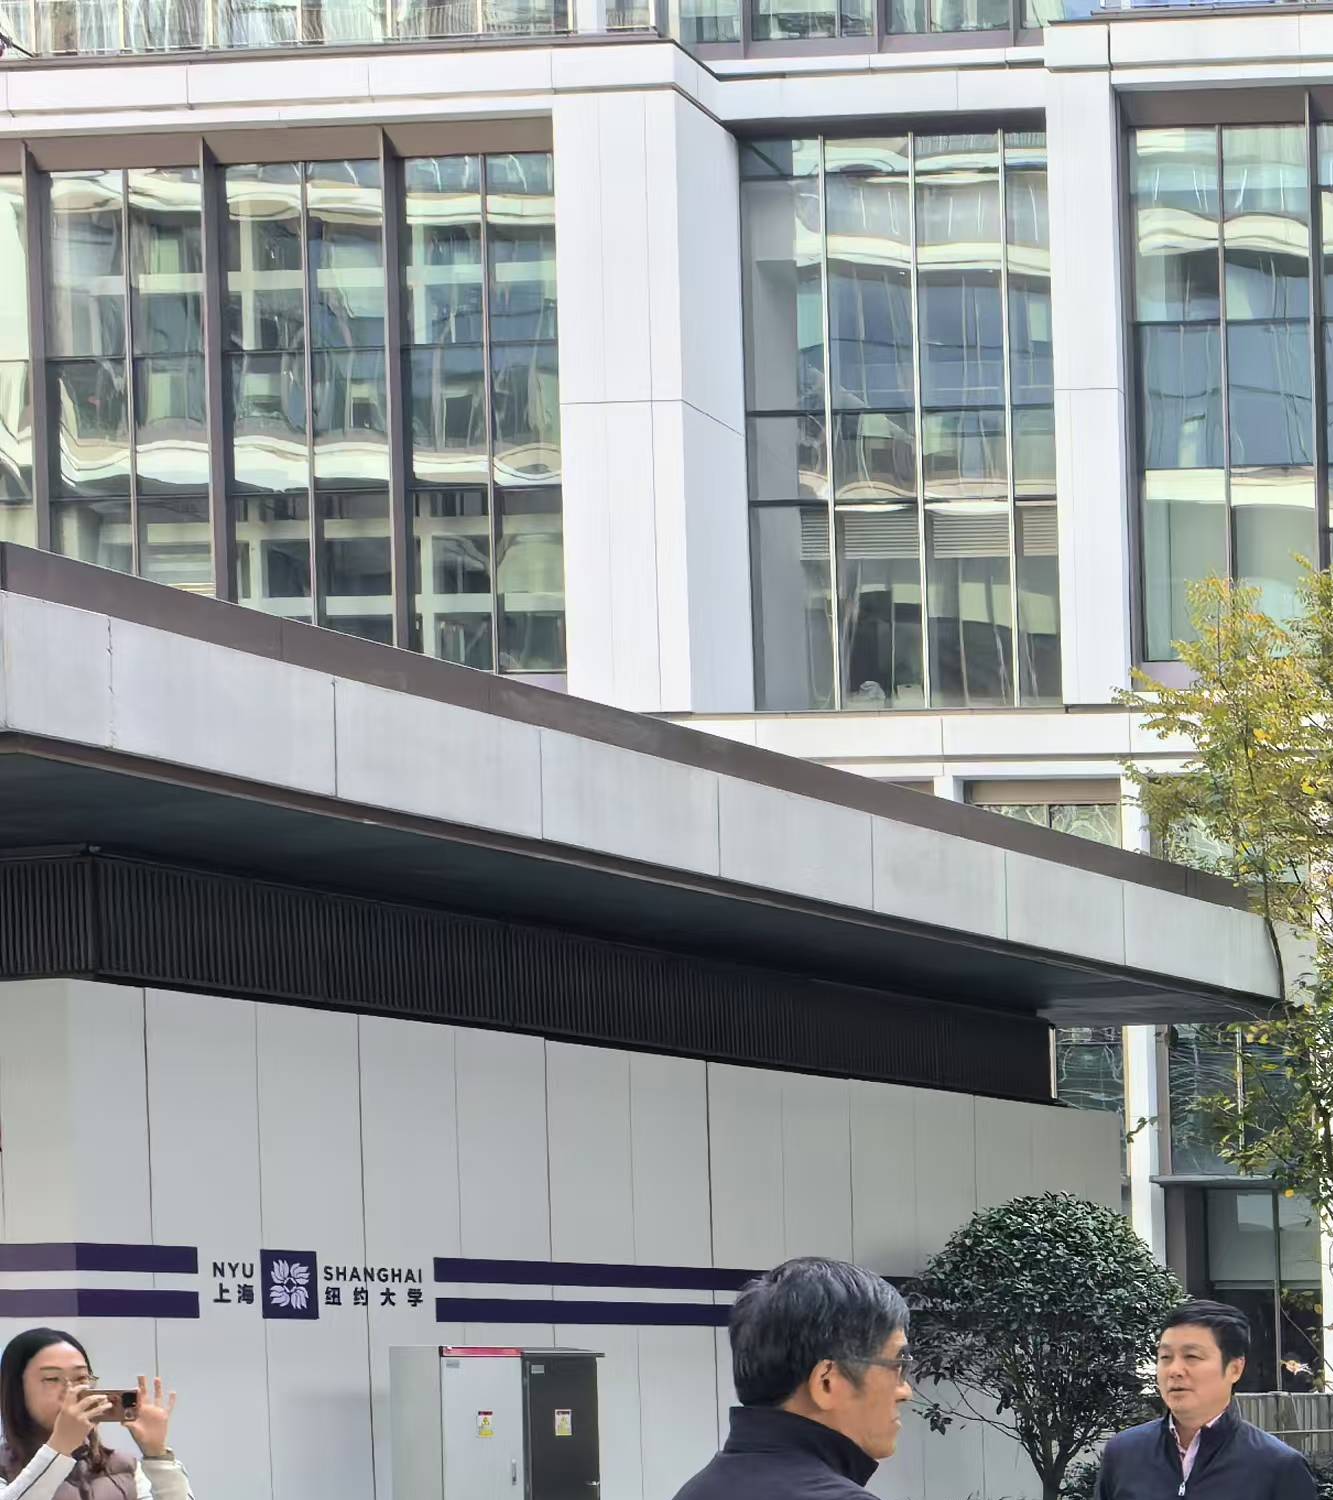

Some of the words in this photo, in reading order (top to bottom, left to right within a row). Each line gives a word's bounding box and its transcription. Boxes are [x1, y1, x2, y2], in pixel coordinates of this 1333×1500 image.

[212, 1262, 255, 1278] NYU
[323, 1265, 423, 1284] SHANGHAI
[213, 1283, 255, 1305] 上海
[324, 1286, 424, 1308] 纽约大学
